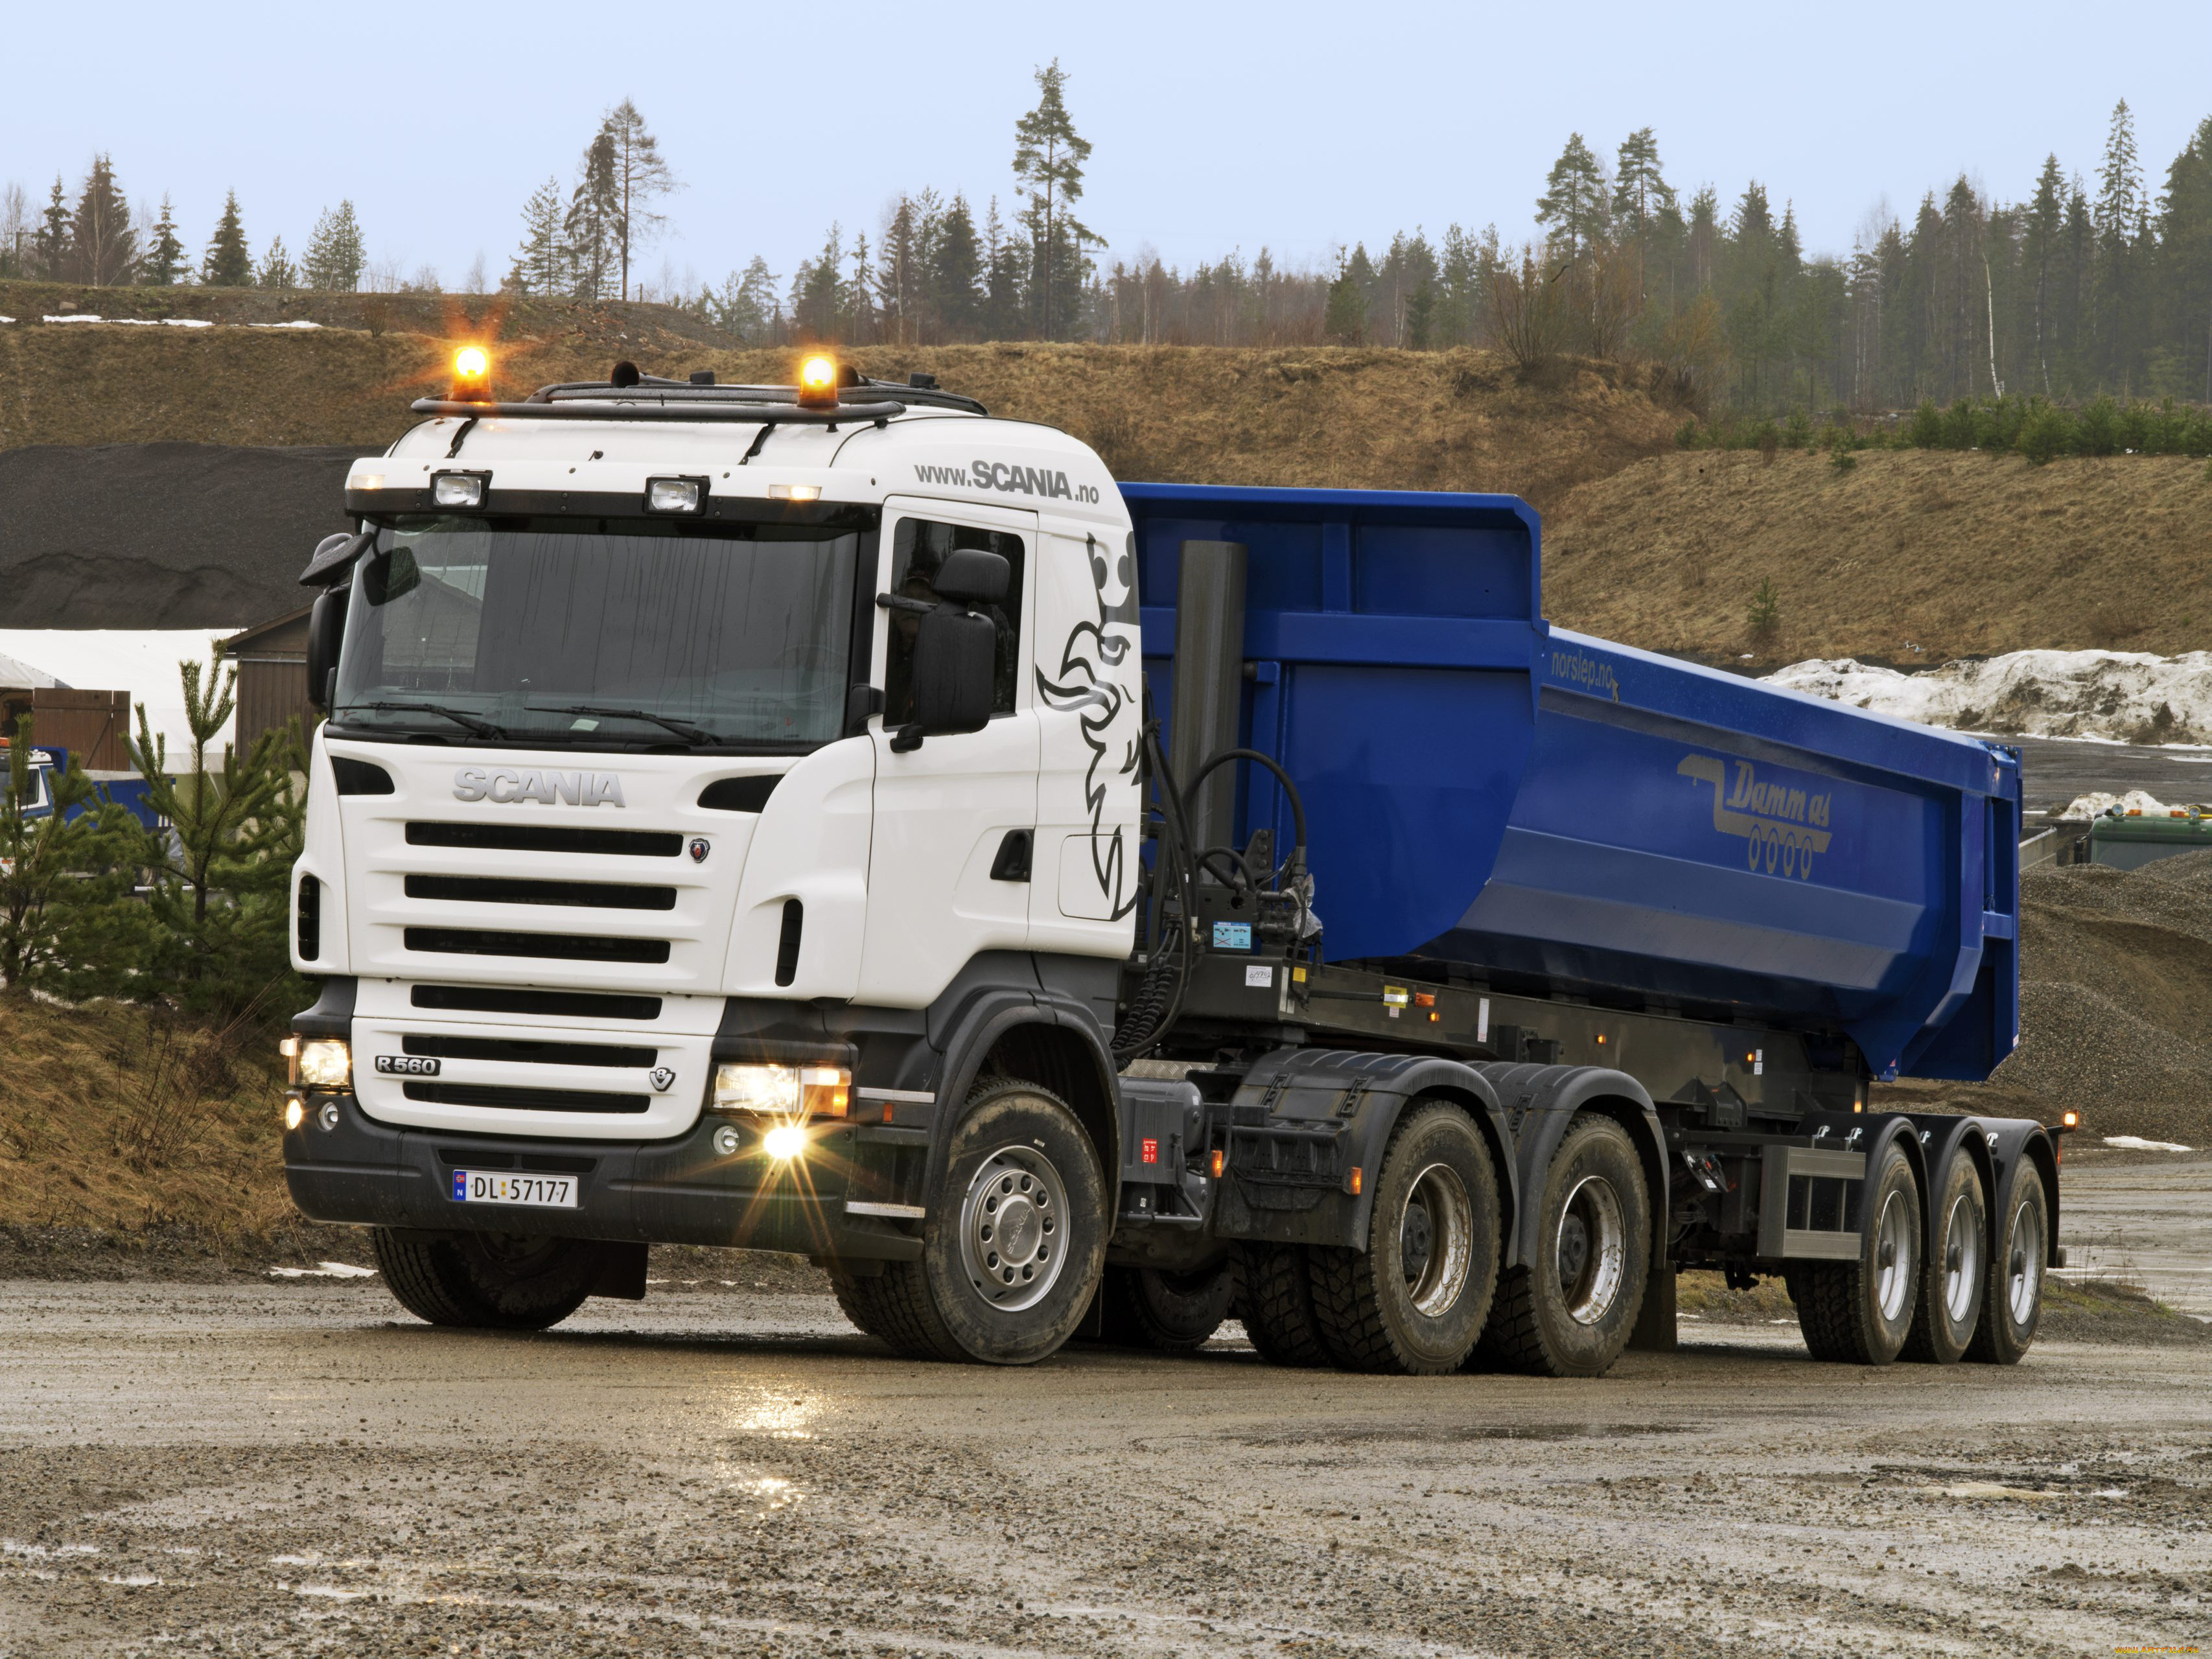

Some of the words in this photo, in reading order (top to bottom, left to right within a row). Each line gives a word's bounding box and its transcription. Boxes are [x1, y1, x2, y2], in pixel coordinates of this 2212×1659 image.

[914, 459, 1099, 505] www.SCANIA.no
[1551, 649, 1612, 691] norslep.no
[453, 767, 626, 808] SCANIA
[1726, 760, 1806, 822] Damm
[377, 1056, 391, 1072] R
[394, 1058, 436, 1074] 560
[457, 1189, 463, 1197] N
